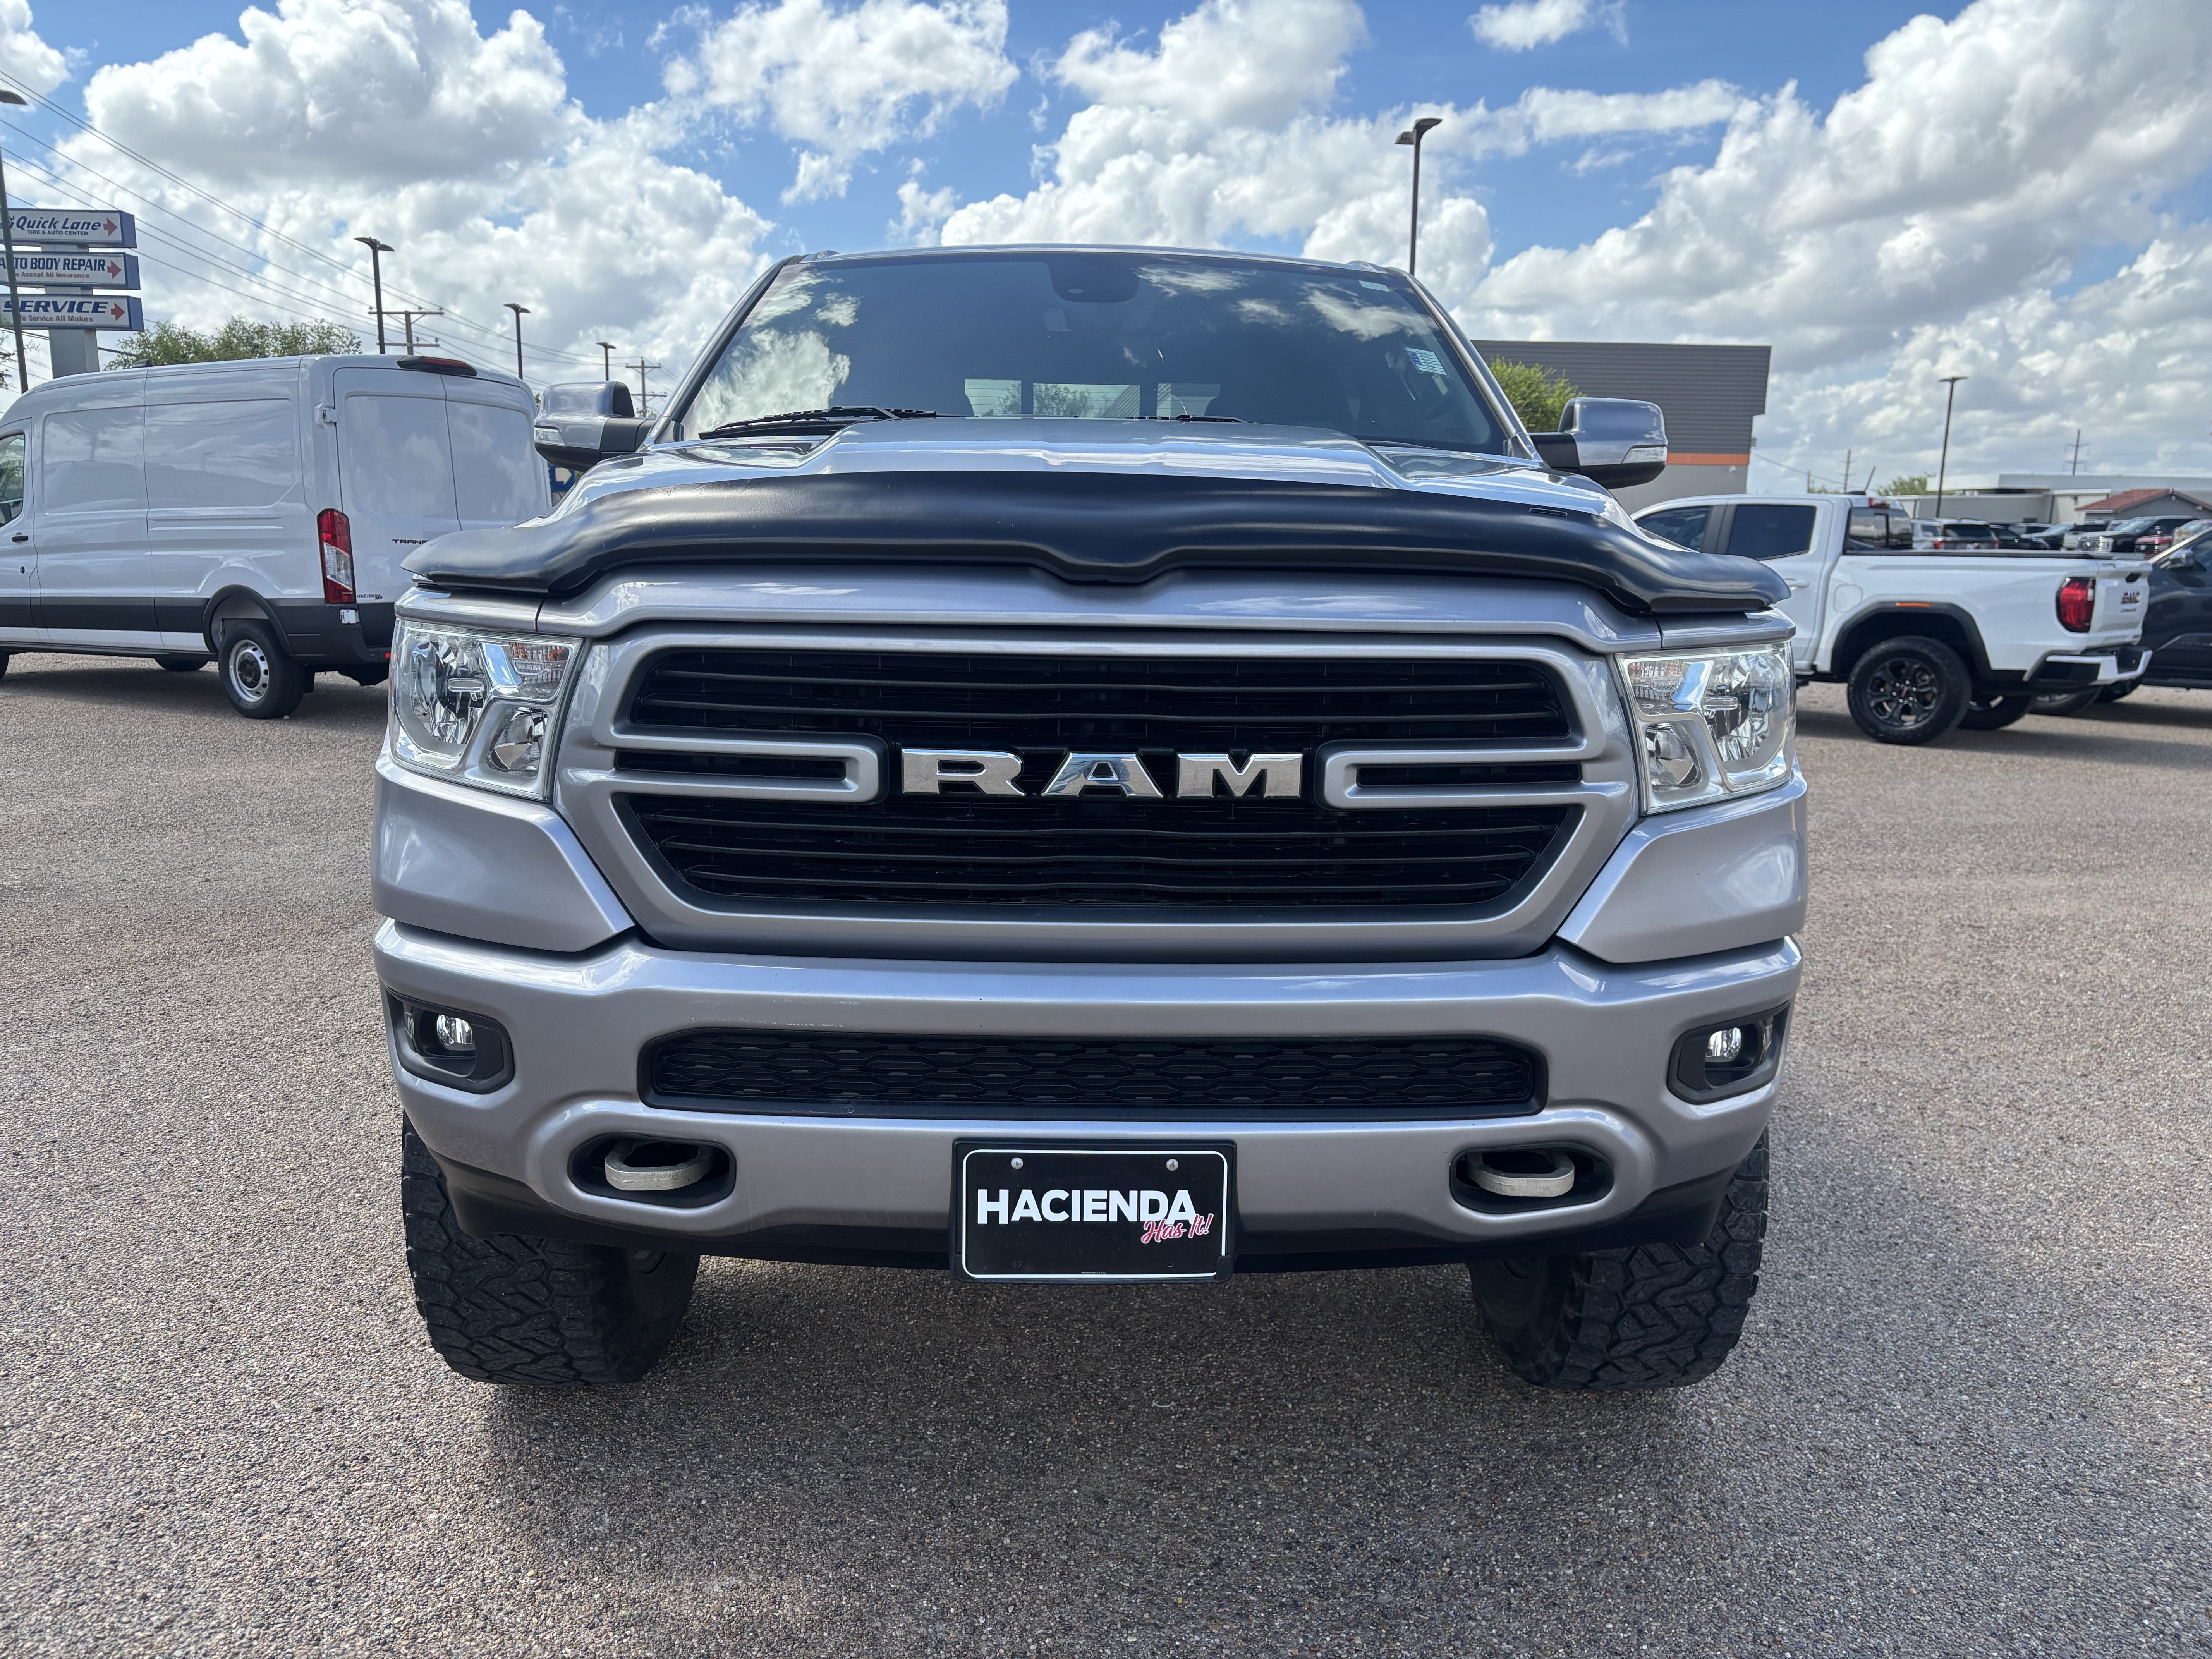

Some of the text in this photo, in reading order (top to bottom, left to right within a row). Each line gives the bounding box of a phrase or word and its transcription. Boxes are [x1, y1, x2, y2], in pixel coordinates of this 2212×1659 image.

[16, 215, 101, 230] Quick Lane
[0, 257, 106, 271] ATO BODY REPAIR
[902, 748, 1303, 798] RAM
[977, 1189, 1197, 1224] HACIENDA
[1141, 1213, 1214, 1244] Has It!
